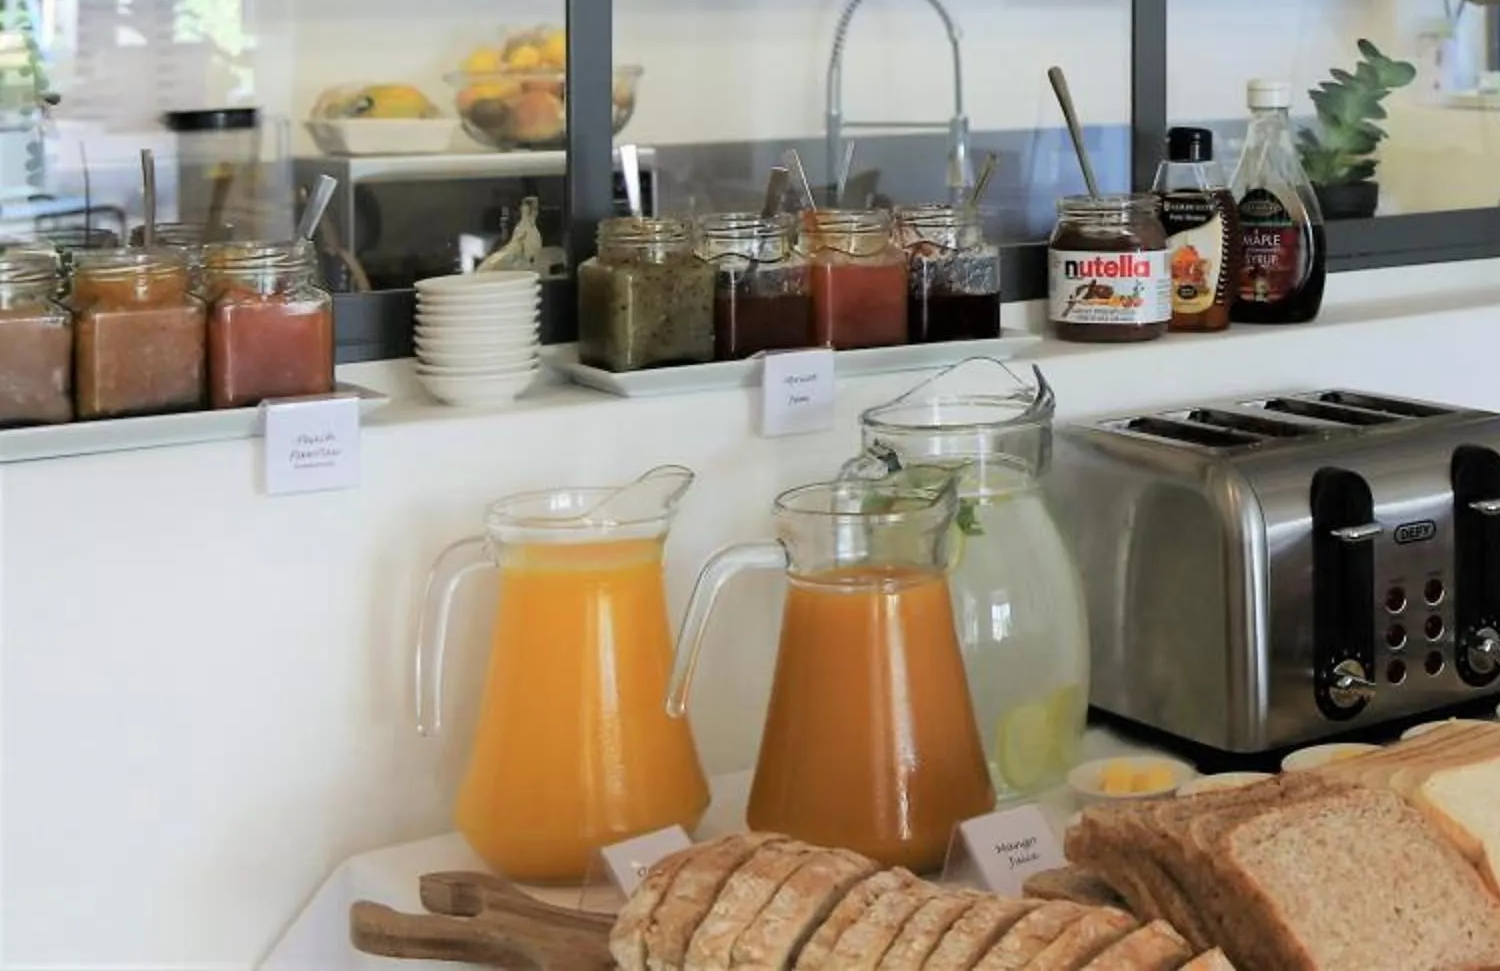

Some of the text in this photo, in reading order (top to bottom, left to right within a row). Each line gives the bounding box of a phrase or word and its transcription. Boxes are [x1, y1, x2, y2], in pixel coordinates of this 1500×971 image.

[1242, 233, 1281, 246] MAPLE
[1065, 255, 1150, 277] nutella
[1400, 523, 1431, 540] DEFY
